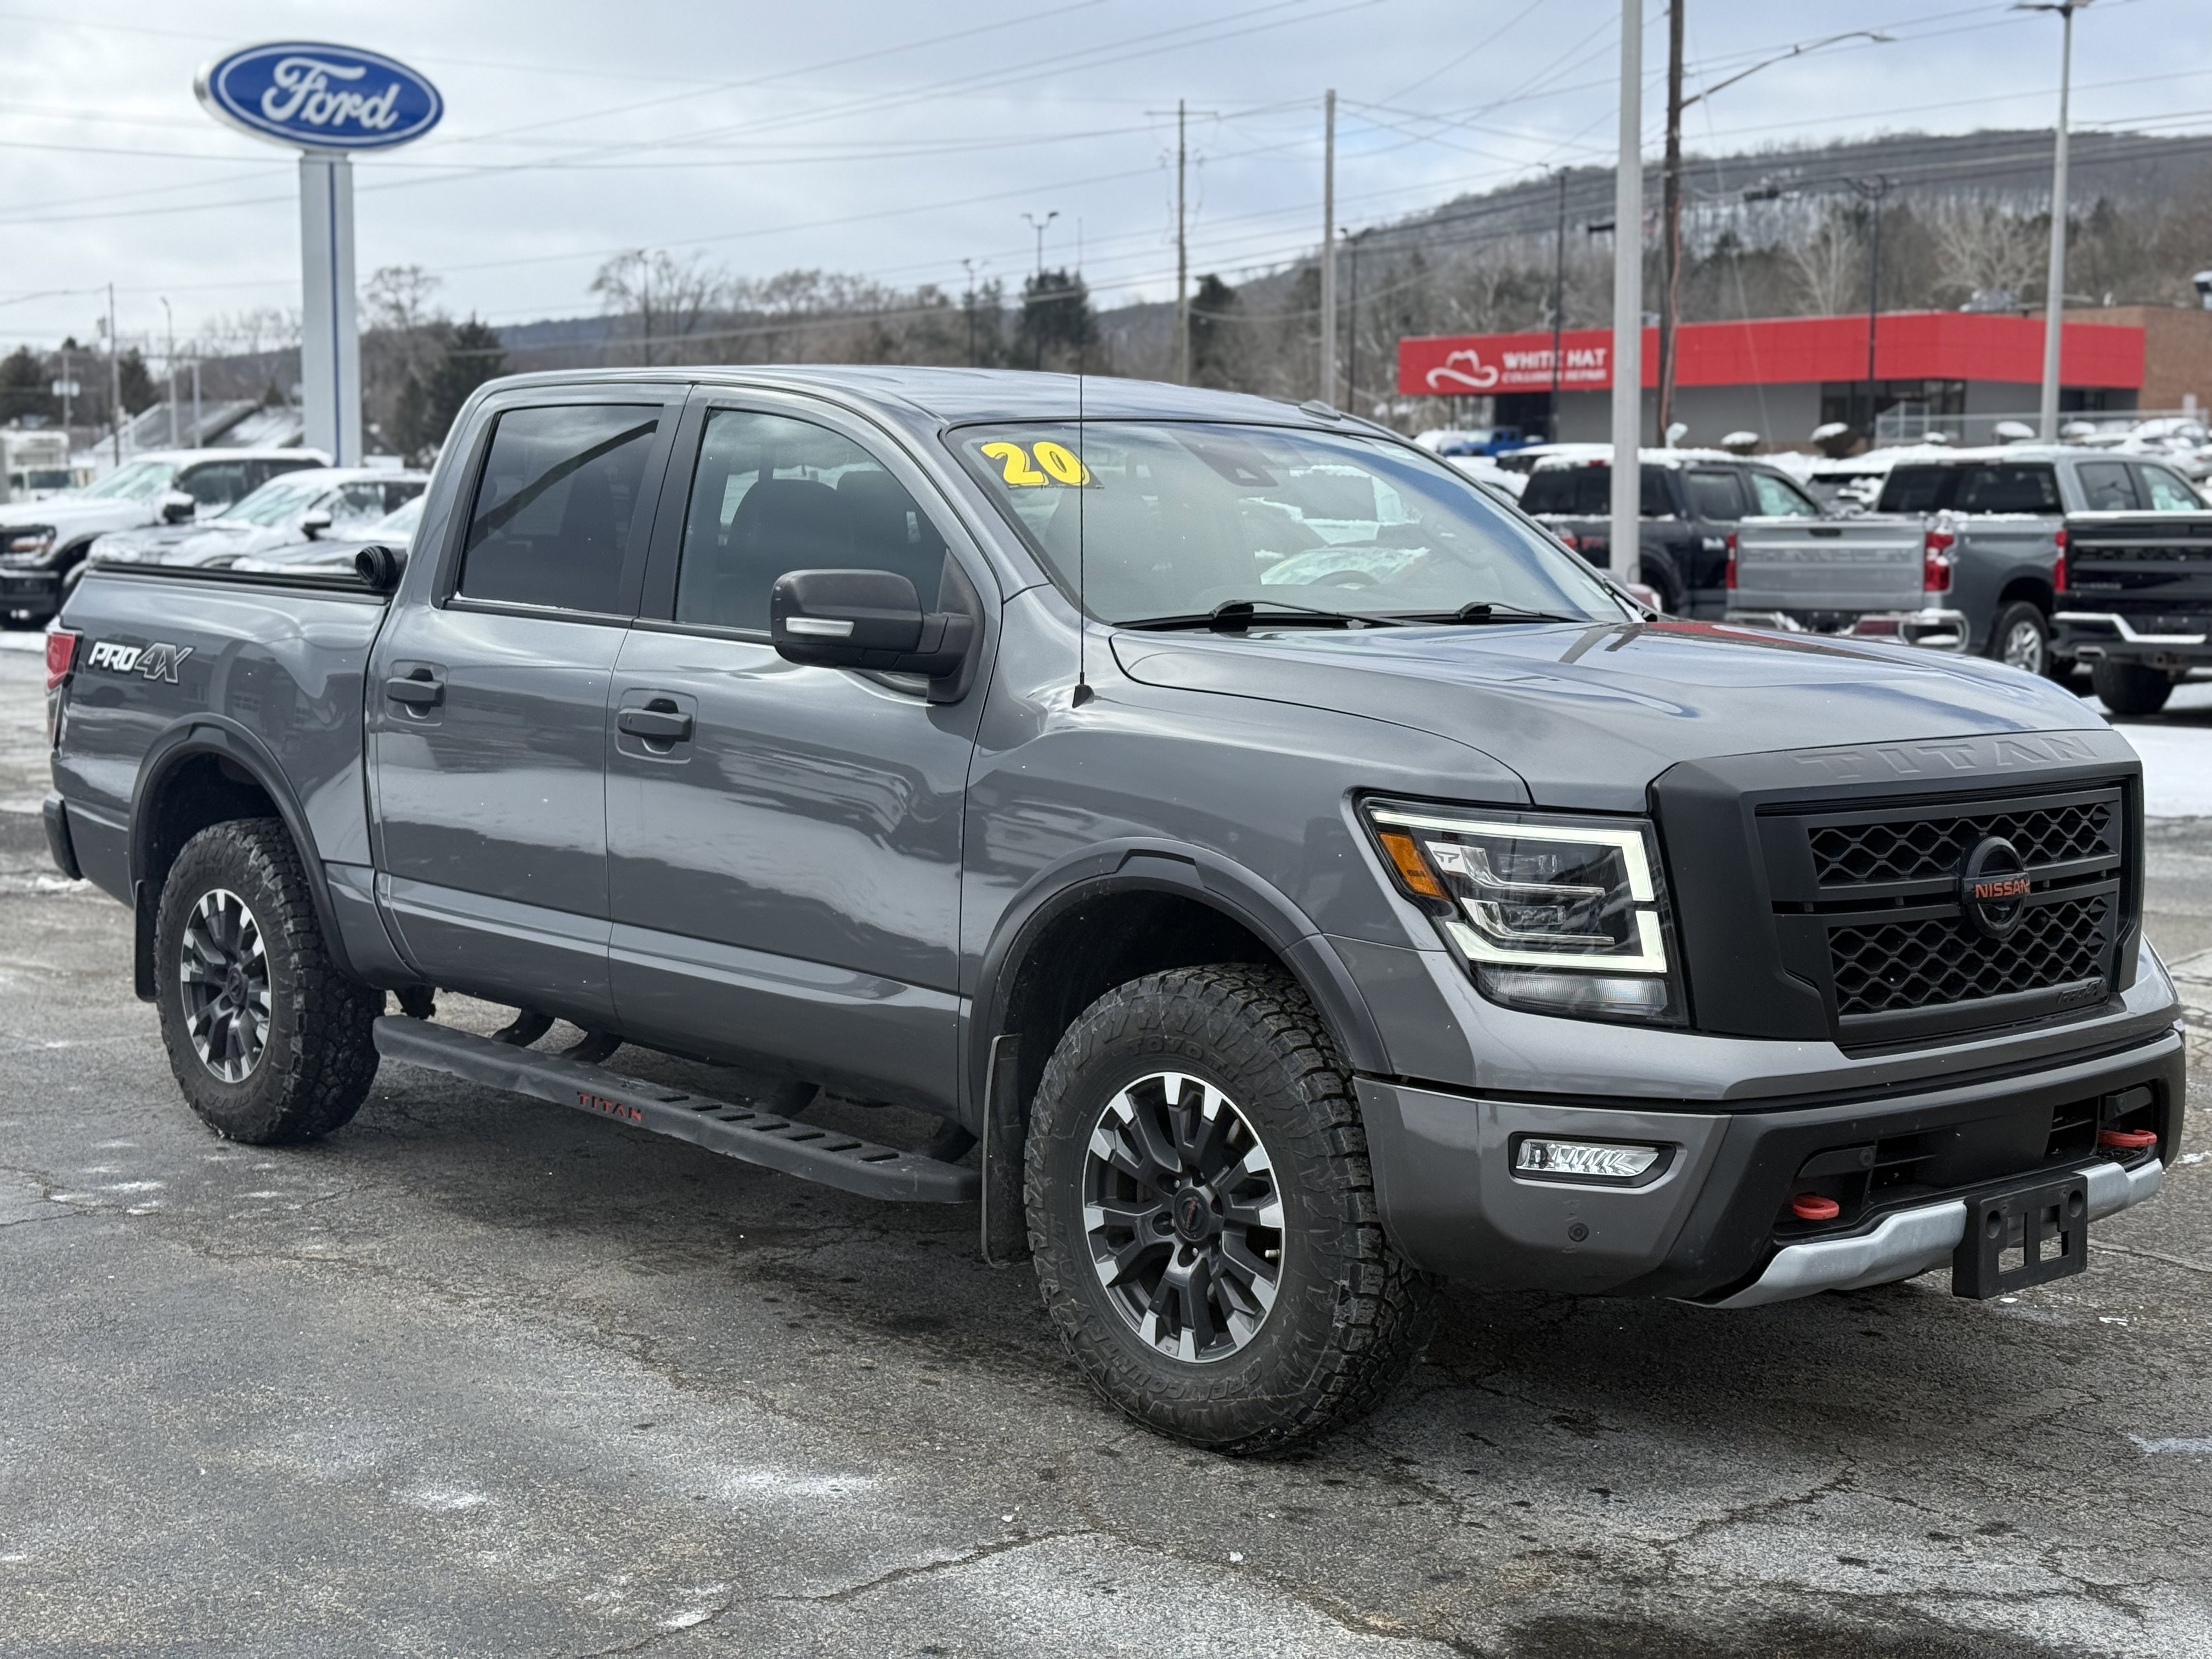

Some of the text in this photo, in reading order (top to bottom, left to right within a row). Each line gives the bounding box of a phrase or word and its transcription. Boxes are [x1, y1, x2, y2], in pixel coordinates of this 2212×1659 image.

[261, 57, 400, 129] Ford
[1502, 347, 1607, 369] WHITE HAT
[980, 441, 1090, 486] 20
[1795, 735, 2099, 779] TITAN
[1975, 878, 2029, 899] NISSAN
[1126, 1034, 1204, 1060] TOYO
[577, 1091, 642, 1124] TITAN
